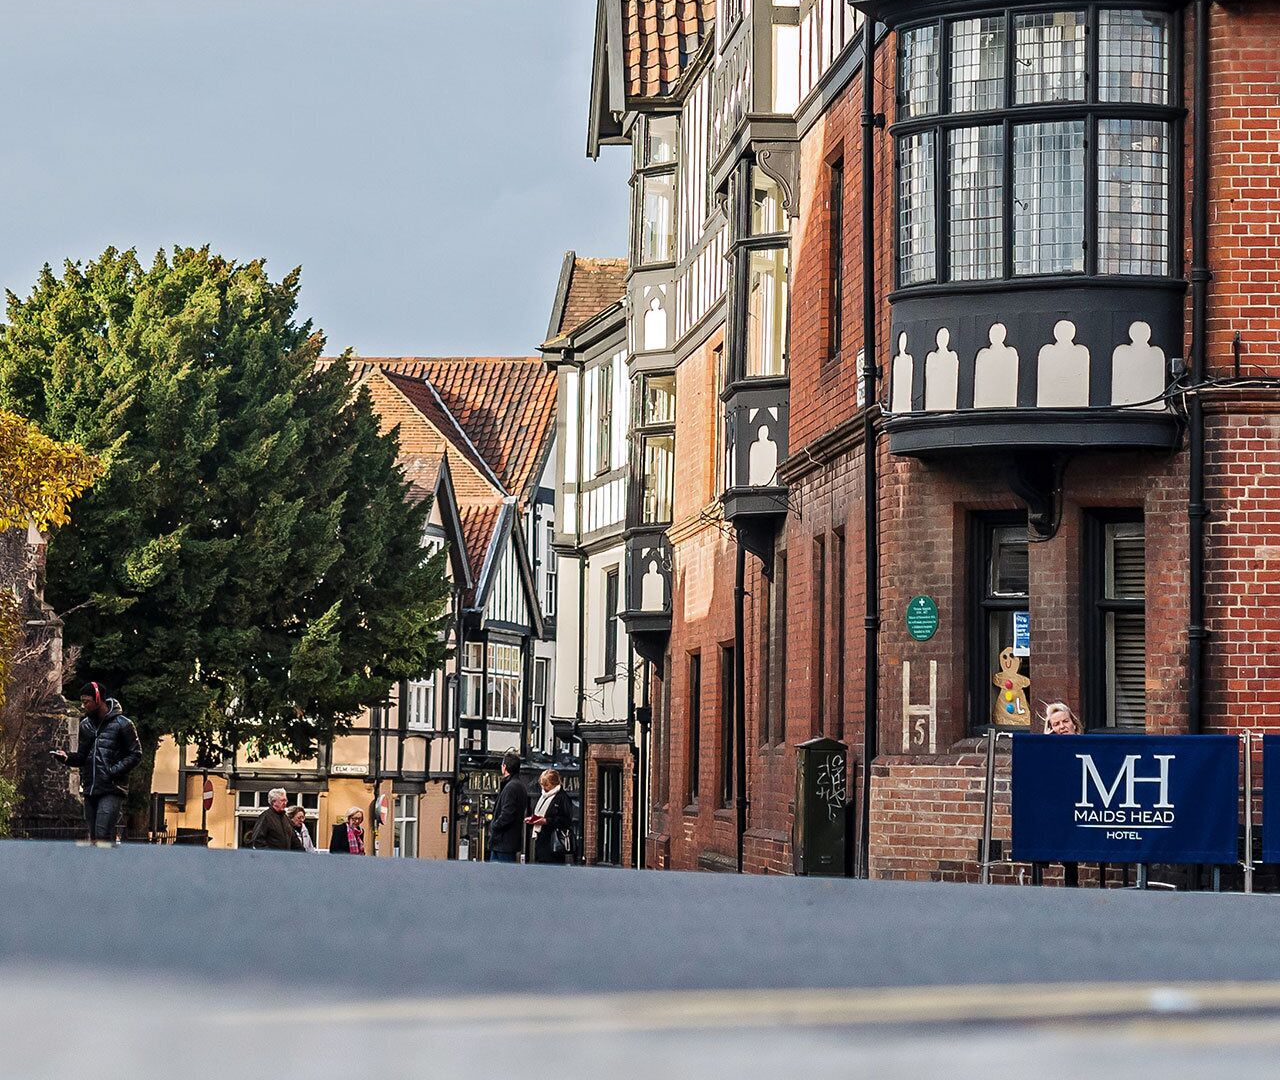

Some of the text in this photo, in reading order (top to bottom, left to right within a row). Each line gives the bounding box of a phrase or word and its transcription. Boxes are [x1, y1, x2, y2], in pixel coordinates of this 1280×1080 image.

[1075, 754, 1175, 808] MH
[1074, 810, 1175, 823] MAIDS HEAD
[1106, 831, 1142, 840] HOTEL
